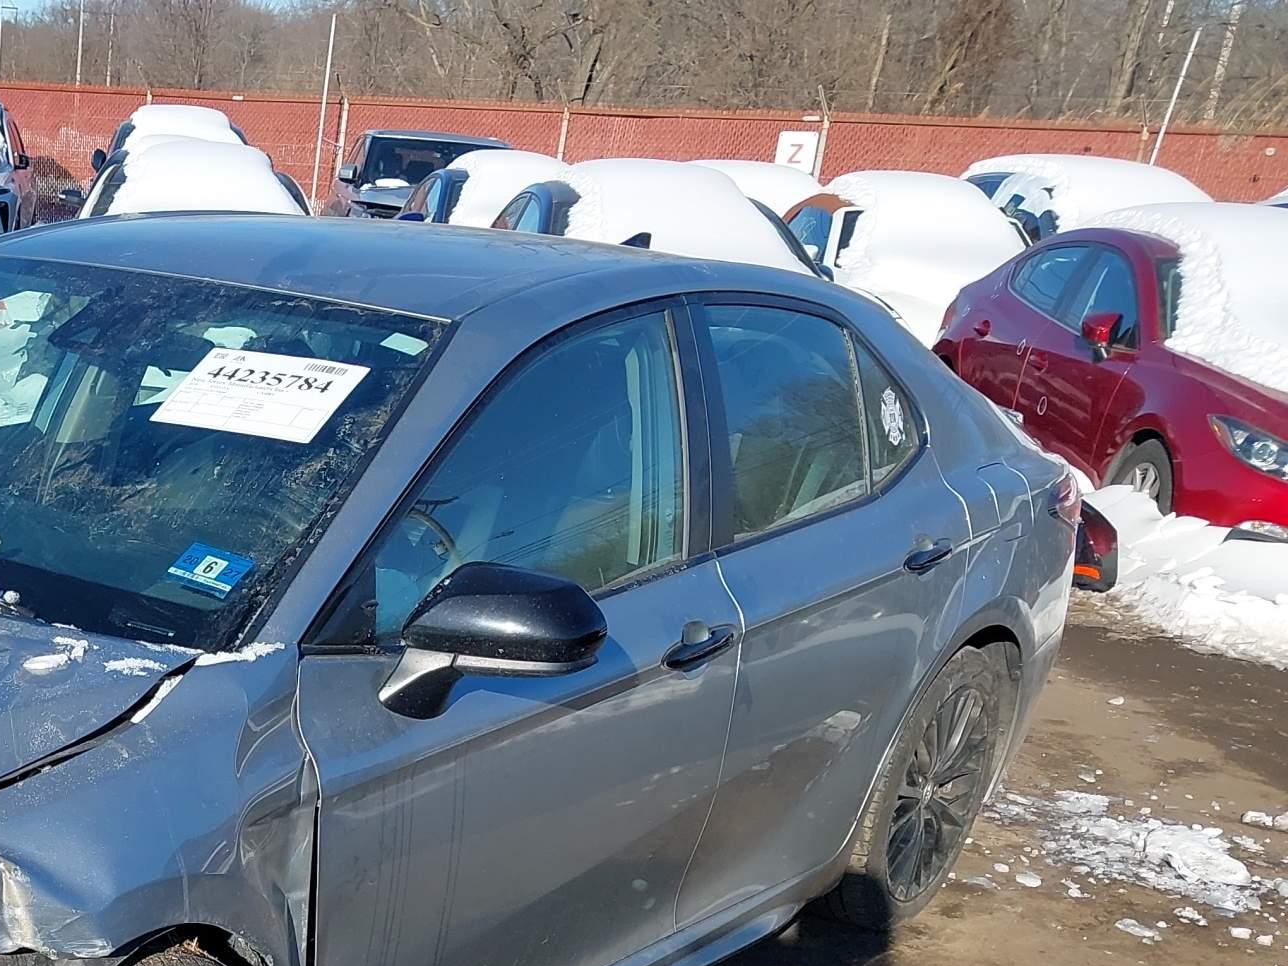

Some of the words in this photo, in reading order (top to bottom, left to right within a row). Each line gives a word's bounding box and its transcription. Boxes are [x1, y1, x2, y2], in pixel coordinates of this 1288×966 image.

[787, 144, 804, 164] Z
[207, 365, 336, 394] 44235784
[202, 561, 218, 574] 6
